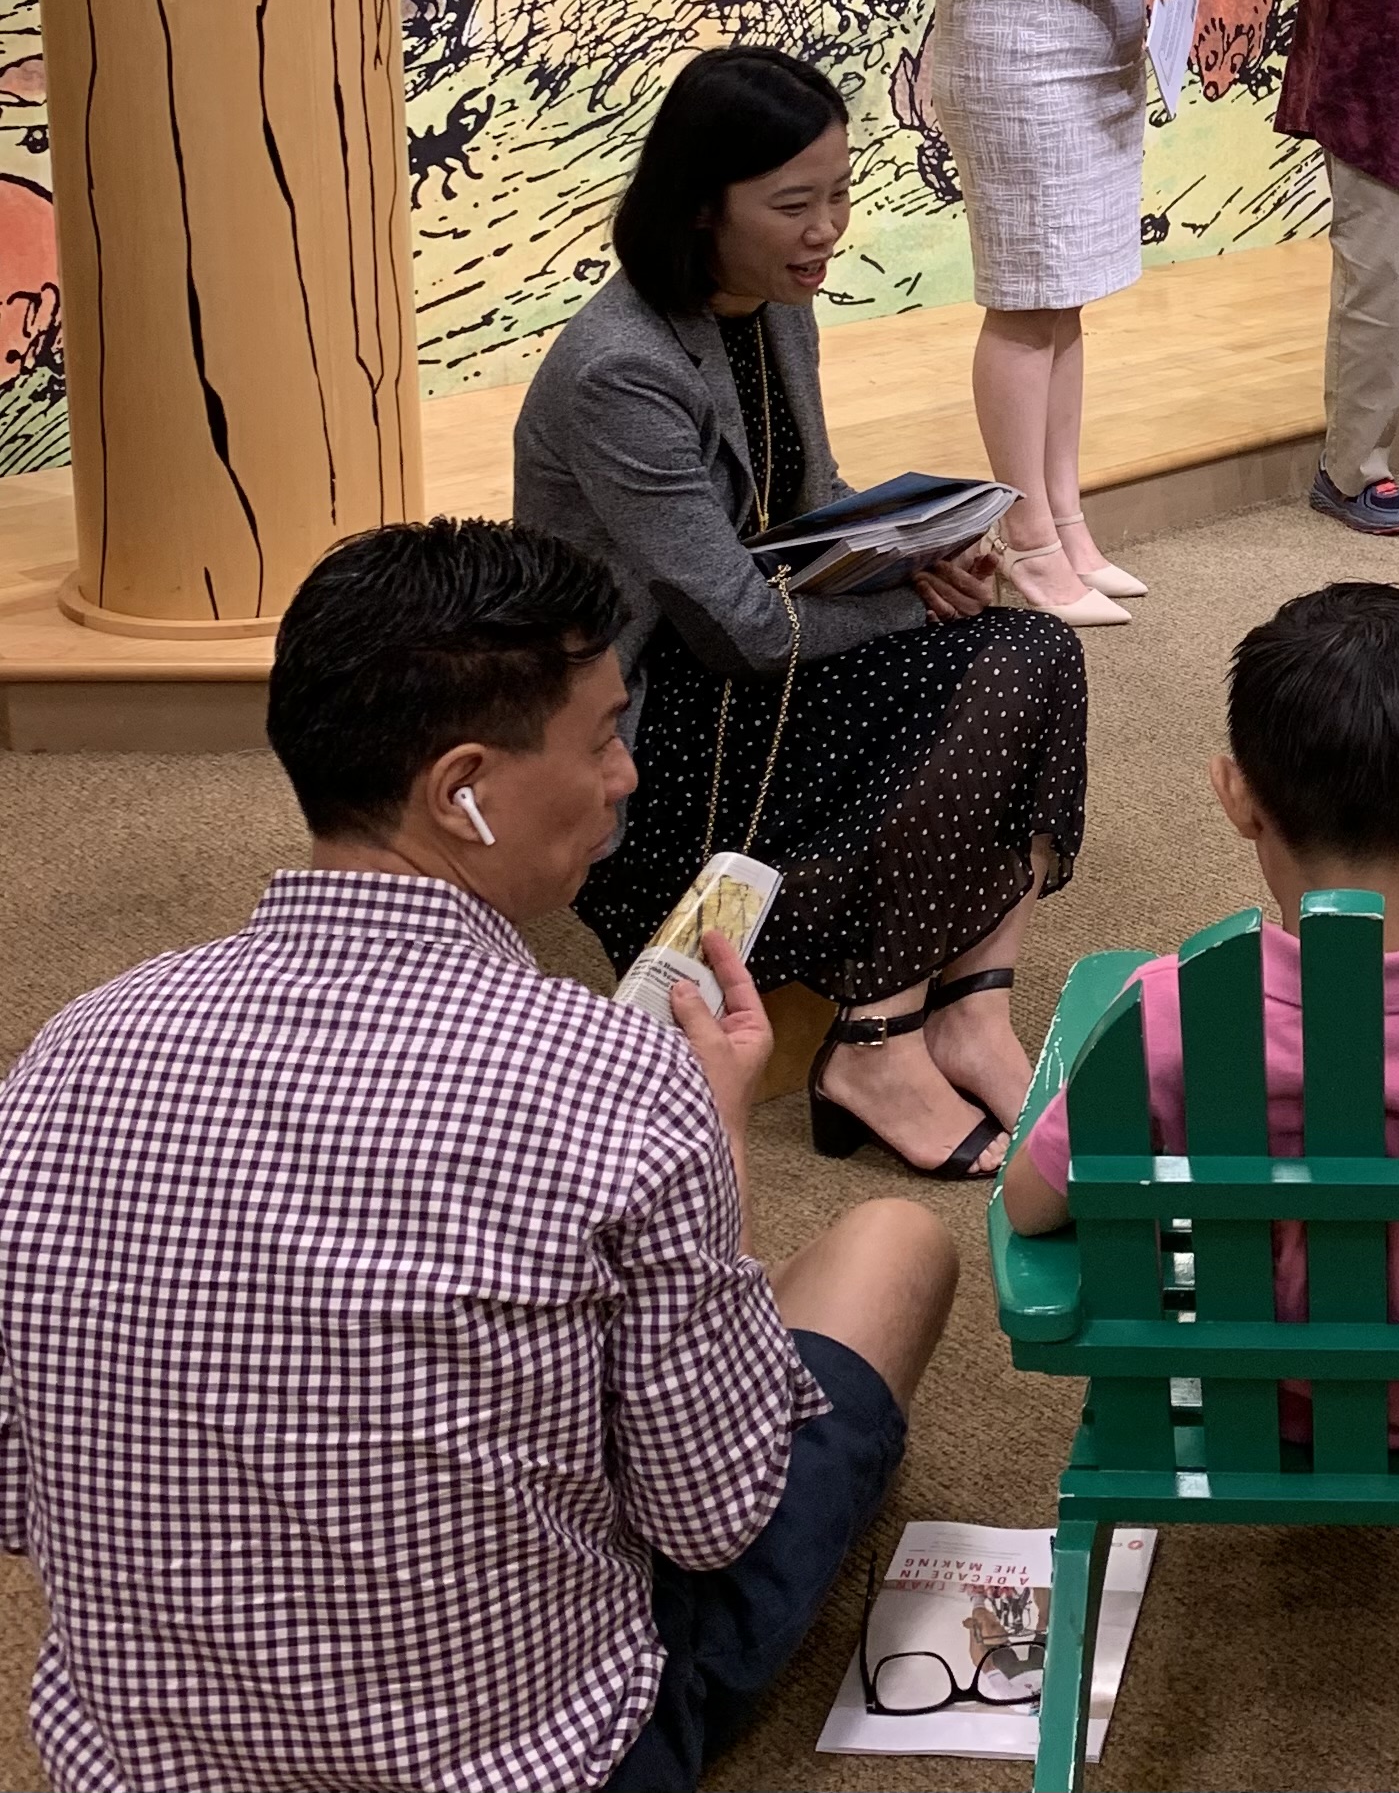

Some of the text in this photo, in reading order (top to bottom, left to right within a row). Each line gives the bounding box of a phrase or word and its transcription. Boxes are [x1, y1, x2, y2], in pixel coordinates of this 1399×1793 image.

[904, 1558, 1028, 1575] THE MAKING
[900, 1569, 1030, 1586] A DECADE IN
